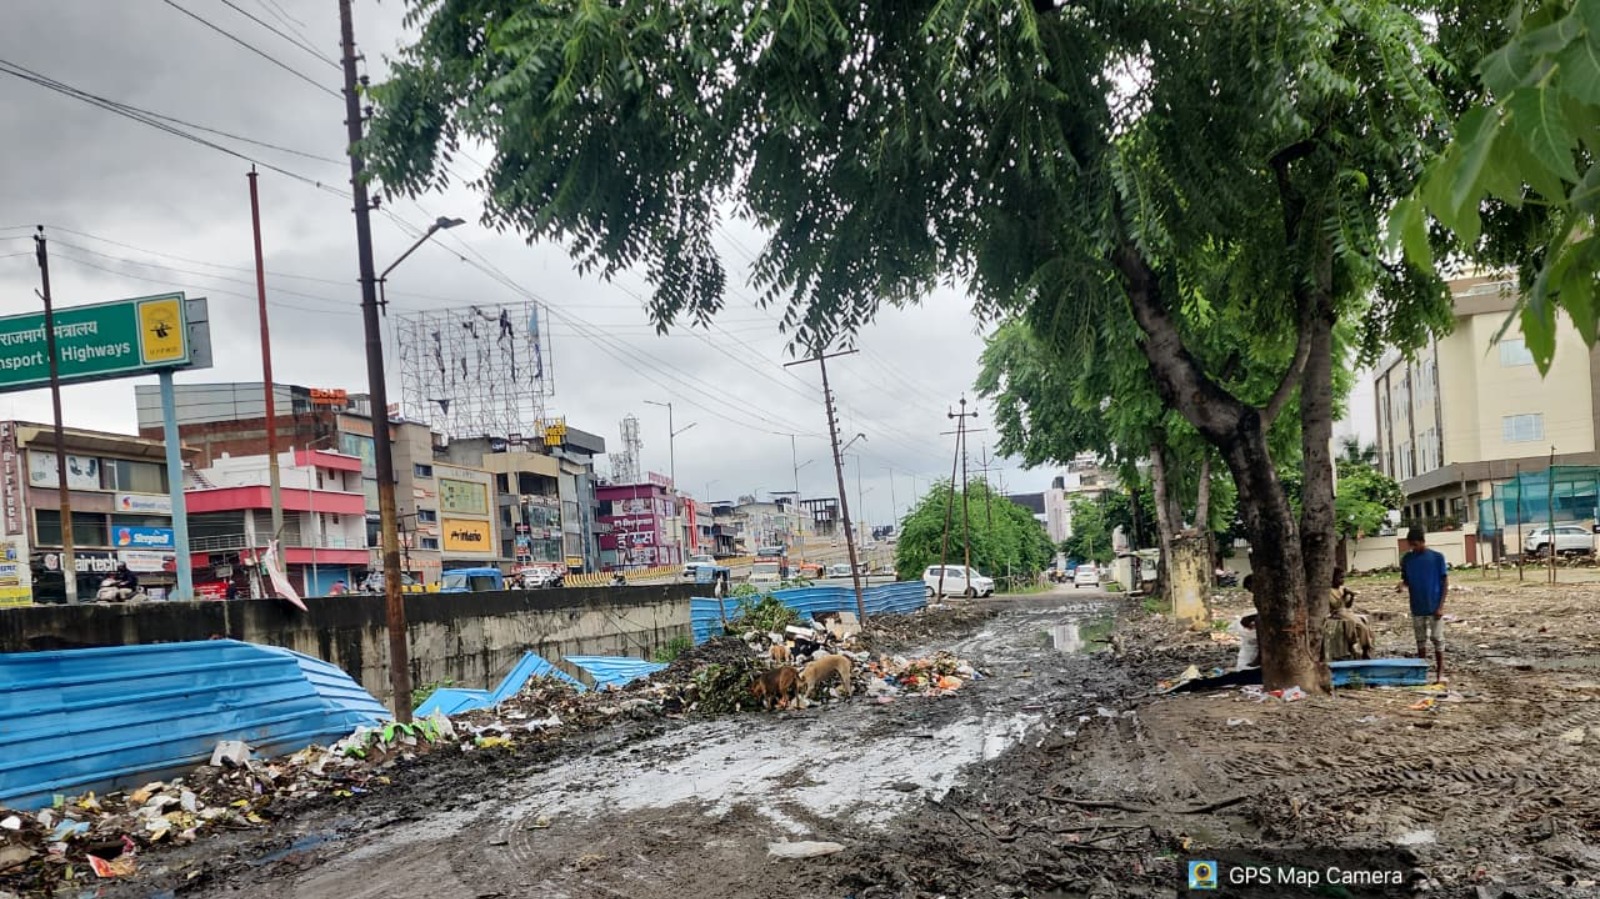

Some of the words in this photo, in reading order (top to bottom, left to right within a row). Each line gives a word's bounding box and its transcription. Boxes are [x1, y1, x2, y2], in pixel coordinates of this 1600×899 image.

[53, 320, 98, 339] मंत्रालय
[61, 341, 131, 362] Highways
[0, 423, 17, 532] Cairtech
[60, 552, 118, 572] Cairtech
